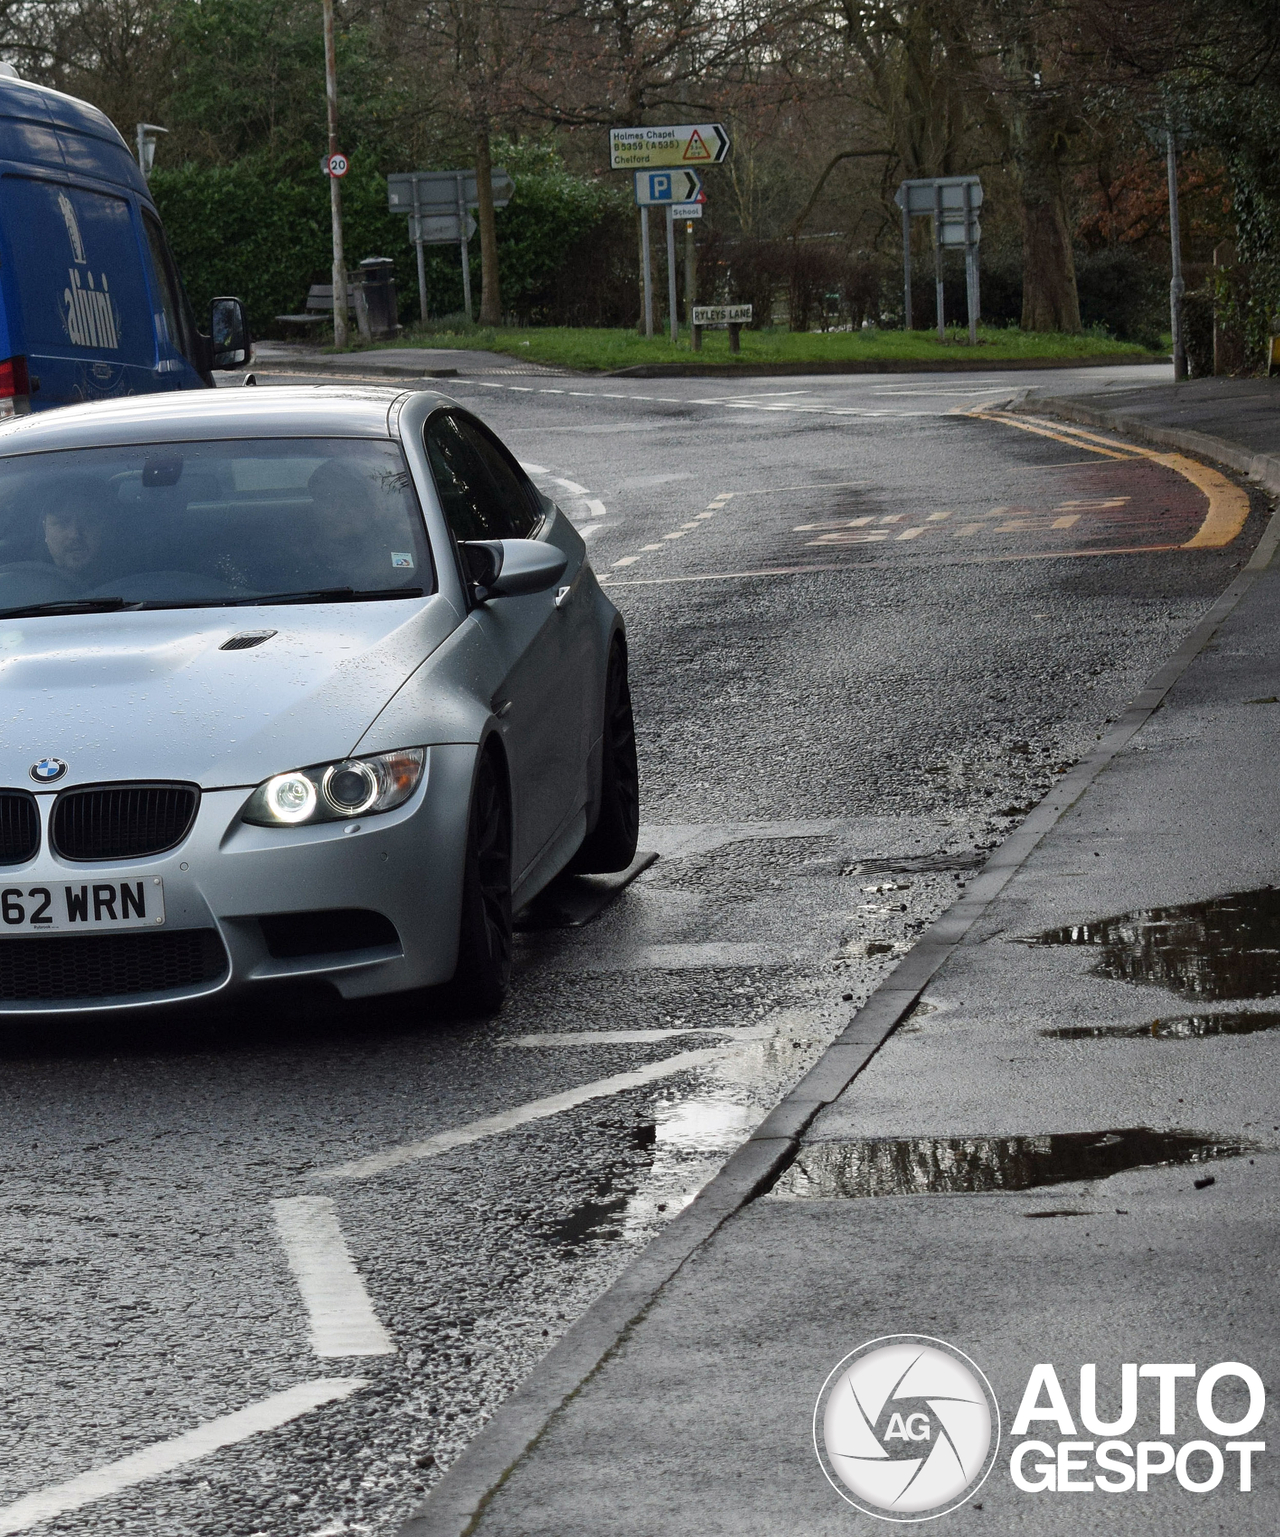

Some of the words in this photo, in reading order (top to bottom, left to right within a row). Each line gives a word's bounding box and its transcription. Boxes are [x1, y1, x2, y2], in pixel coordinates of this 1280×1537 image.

[614, 132, 644, 140] Holmes
[646, 130, 675, 140] Chapel
[331, 160, 346, 170] 20
[614, 155, 650, 164] Chelford
[653, 176, 668, 198] P
[673, 208, 699, 216] School
[64, 268, 119, 349] alivini
[694, 310, 726, 320] RYLEYS
[729, 308, 751, 319] LANE
[65, 881, 147, 923] WRN
